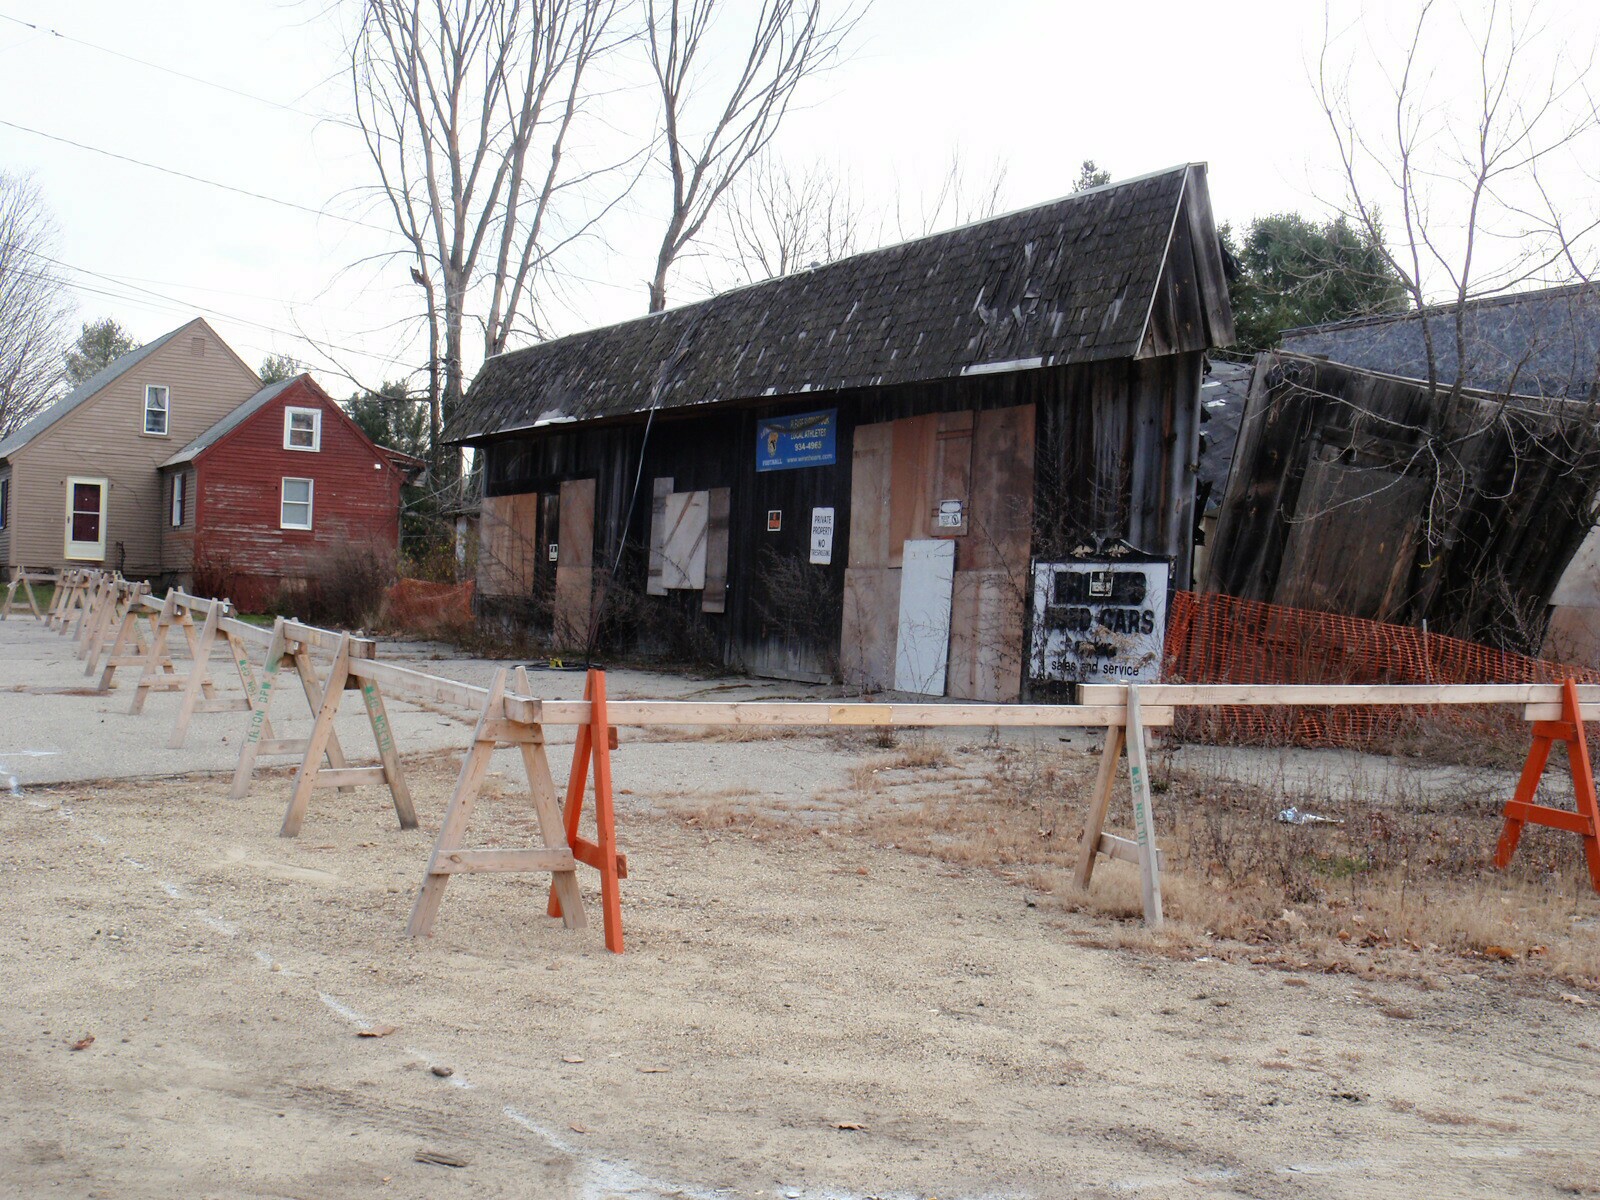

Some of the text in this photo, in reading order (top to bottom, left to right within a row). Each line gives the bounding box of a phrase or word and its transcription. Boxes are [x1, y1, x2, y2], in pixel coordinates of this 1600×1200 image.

[790, 429, 804, 440] LOCAL
[804, 428, 827, 438] ATHLETES
[794, 441, 822, 452] 934-4965
[814, 515, 832, 524] PRIVATE
[812, 526, 832, 536] PROPERTY
[817, 539, 826, 548] NO
[1100, 608, 1155, 635] CARS
[1103, 663, 1139, 676] service
[247, 681, 272, 743] TILTON DPW
[1131, 766, 1147, 847] TILTON DPW
